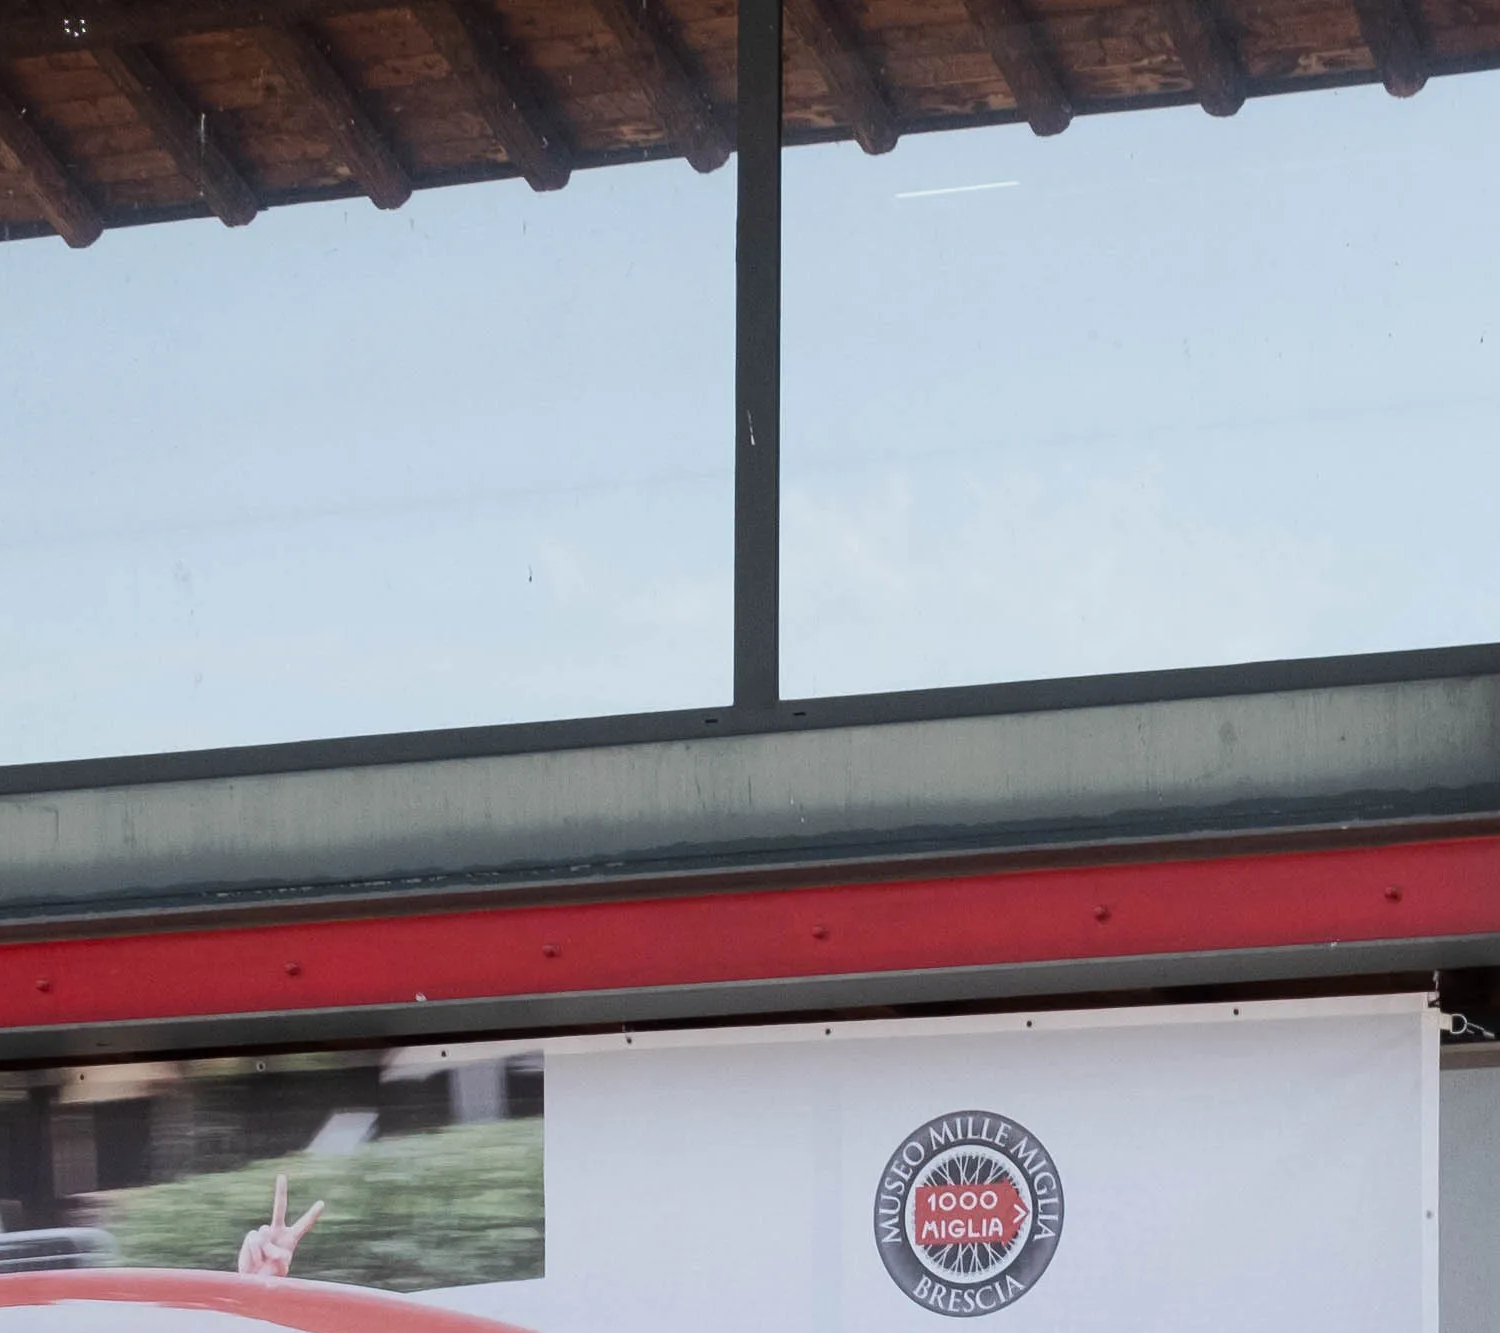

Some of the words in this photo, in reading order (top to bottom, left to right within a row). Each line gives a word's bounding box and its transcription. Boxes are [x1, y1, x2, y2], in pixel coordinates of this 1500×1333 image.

[878, 1140, 925, 1243] MUSEO
[928, 1116, 1012, 1150] MILLE
[1010, 1136, 1059, 1242] MIGLIA
[927, 1190, 998, 1212] 1000
[921, 1217, 1003, 1239] MIGLIA
[913, 1274, 1025, 1312] BRESCIA
